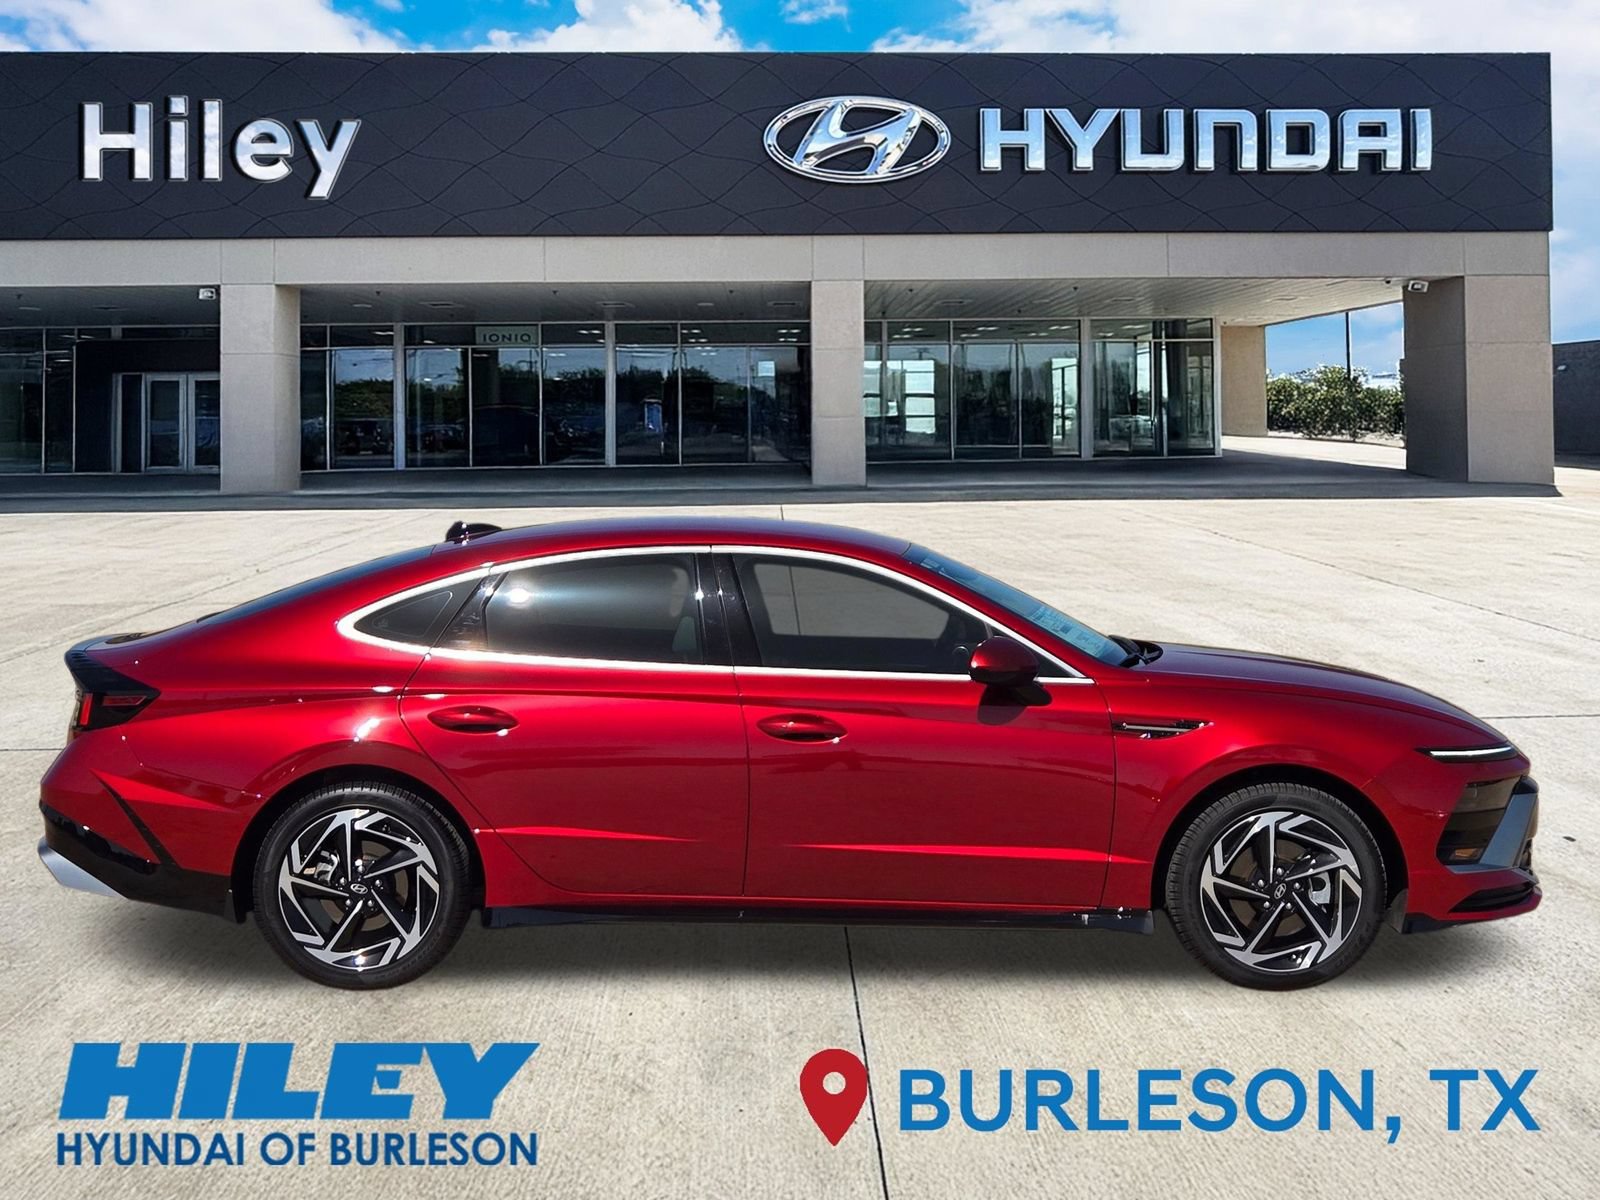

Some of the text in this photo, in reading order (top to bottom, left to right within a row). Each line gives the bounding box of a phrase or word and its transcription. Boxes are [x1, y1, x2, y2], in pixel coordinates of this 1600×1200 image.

[81, 96, 361, 199] Hiley
[979, 107, 1433, 172] HYUNDAI
[482, 332, 532, 343] IONIQ
